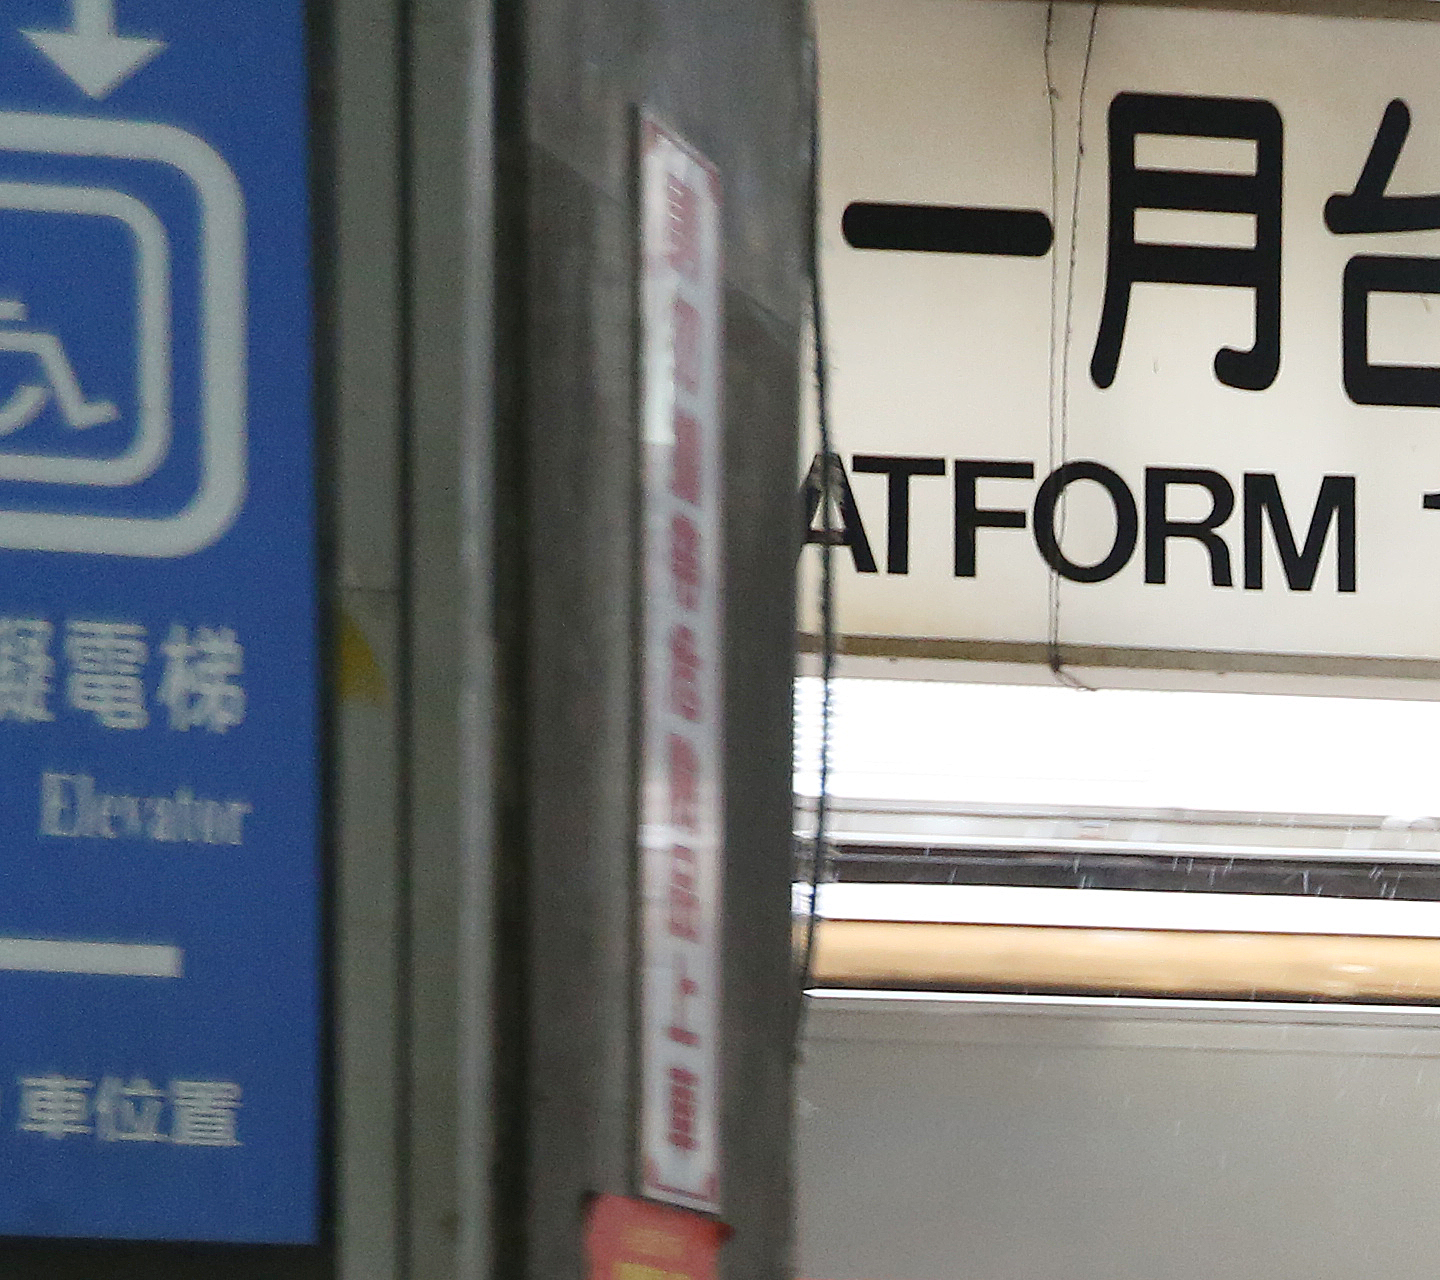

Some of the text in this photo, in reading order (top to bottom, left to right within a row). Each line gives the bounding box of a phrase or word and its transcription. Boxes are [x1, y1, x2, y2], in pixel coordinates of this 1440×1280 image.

[40, 770, 253, 847] Elevator
[0, 1073, 244, 1148] 車位置
